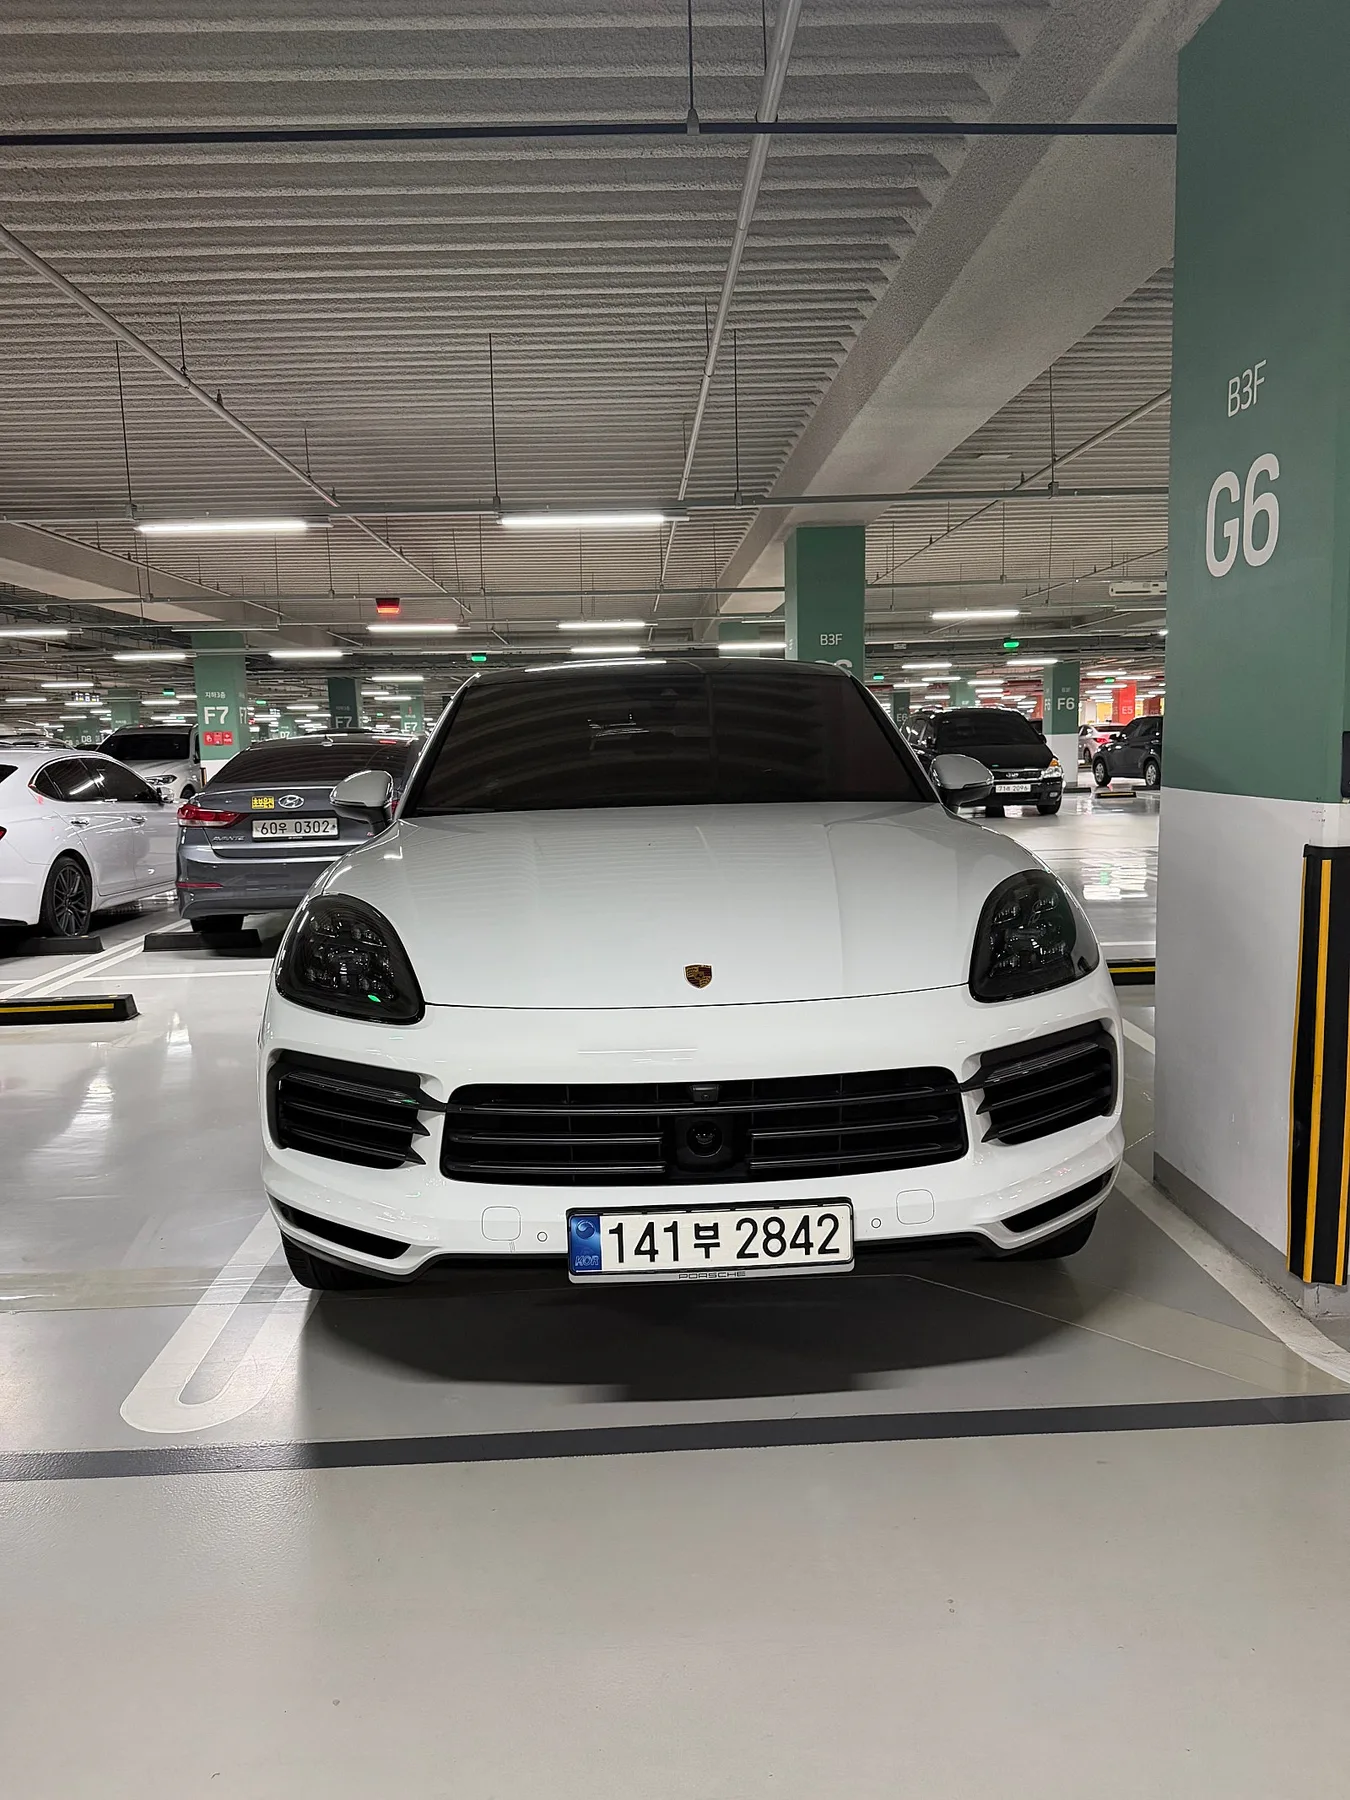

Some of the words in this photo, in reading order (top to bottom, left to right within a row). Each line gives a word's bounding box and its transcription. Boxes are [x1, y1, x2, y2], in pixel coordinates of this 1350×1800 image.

[1227, 359, 1267, 418] B3F
[1205, 453, 1280, 578] G6
[820, 633, 843, 646] B3F
[205, 691, 226, 699] 지하3층
[1057, 697, 1075, 711] F6
[1121, 705, 1133, 715] E5
[203, 706, 229, 725] F7
[260, 821, 288, 835] 60우
[294, 820, 330, 834] 0302
[212, 834, 246, 842] AVANTE
[608, 1220, 721, 1264] 141부
[735, 1213, 840, 1260] 2842
[574, 1254, 600, 1267] KOR
[677, 1270, 746, 1281] PORSCHE
